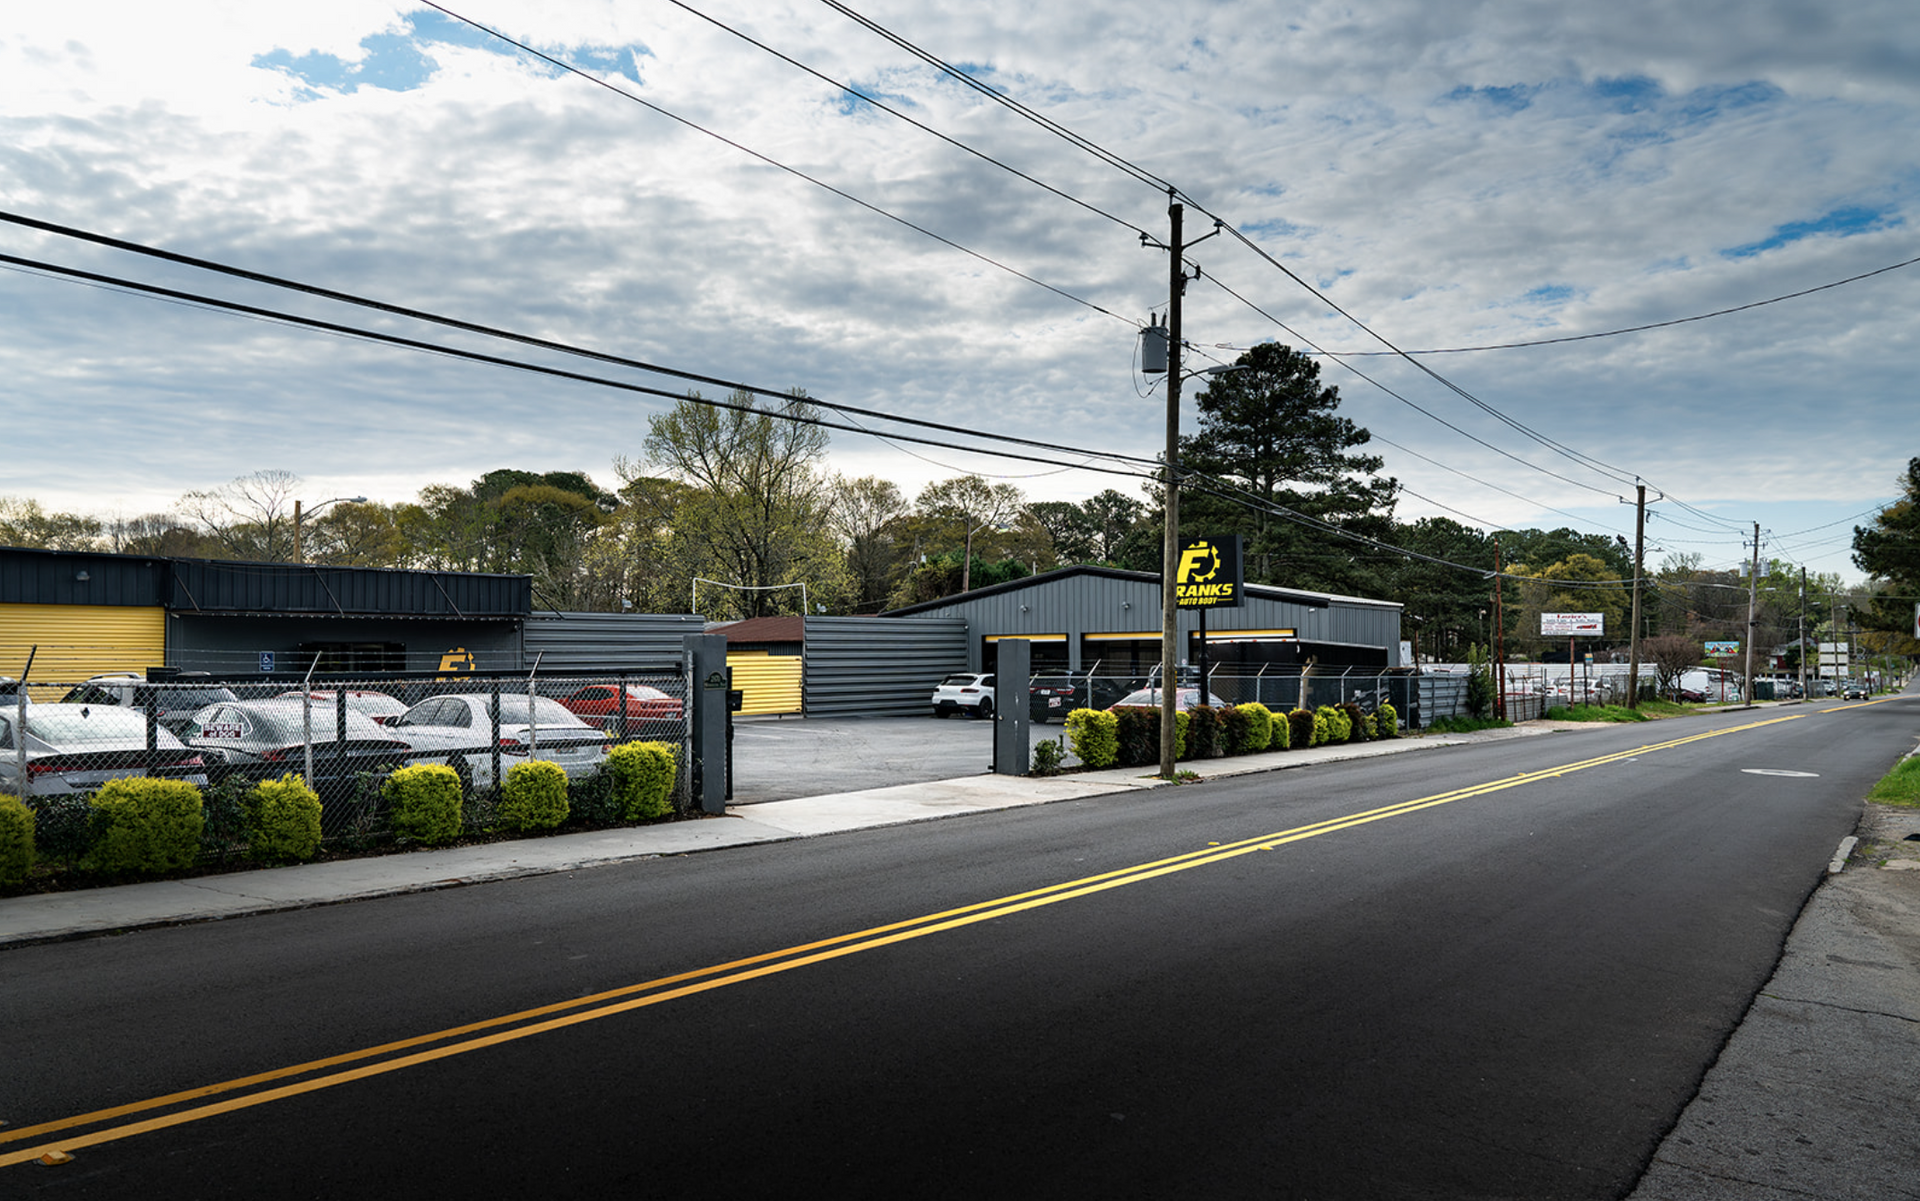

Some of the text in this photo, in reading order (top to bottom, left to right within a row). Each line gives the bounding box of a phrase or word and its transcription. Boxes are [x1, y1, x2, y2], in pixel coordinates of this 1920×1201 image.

[1177, 583, 1233, 597] RANKS
[1179, 597, 1217, 605] AUTO BODY
